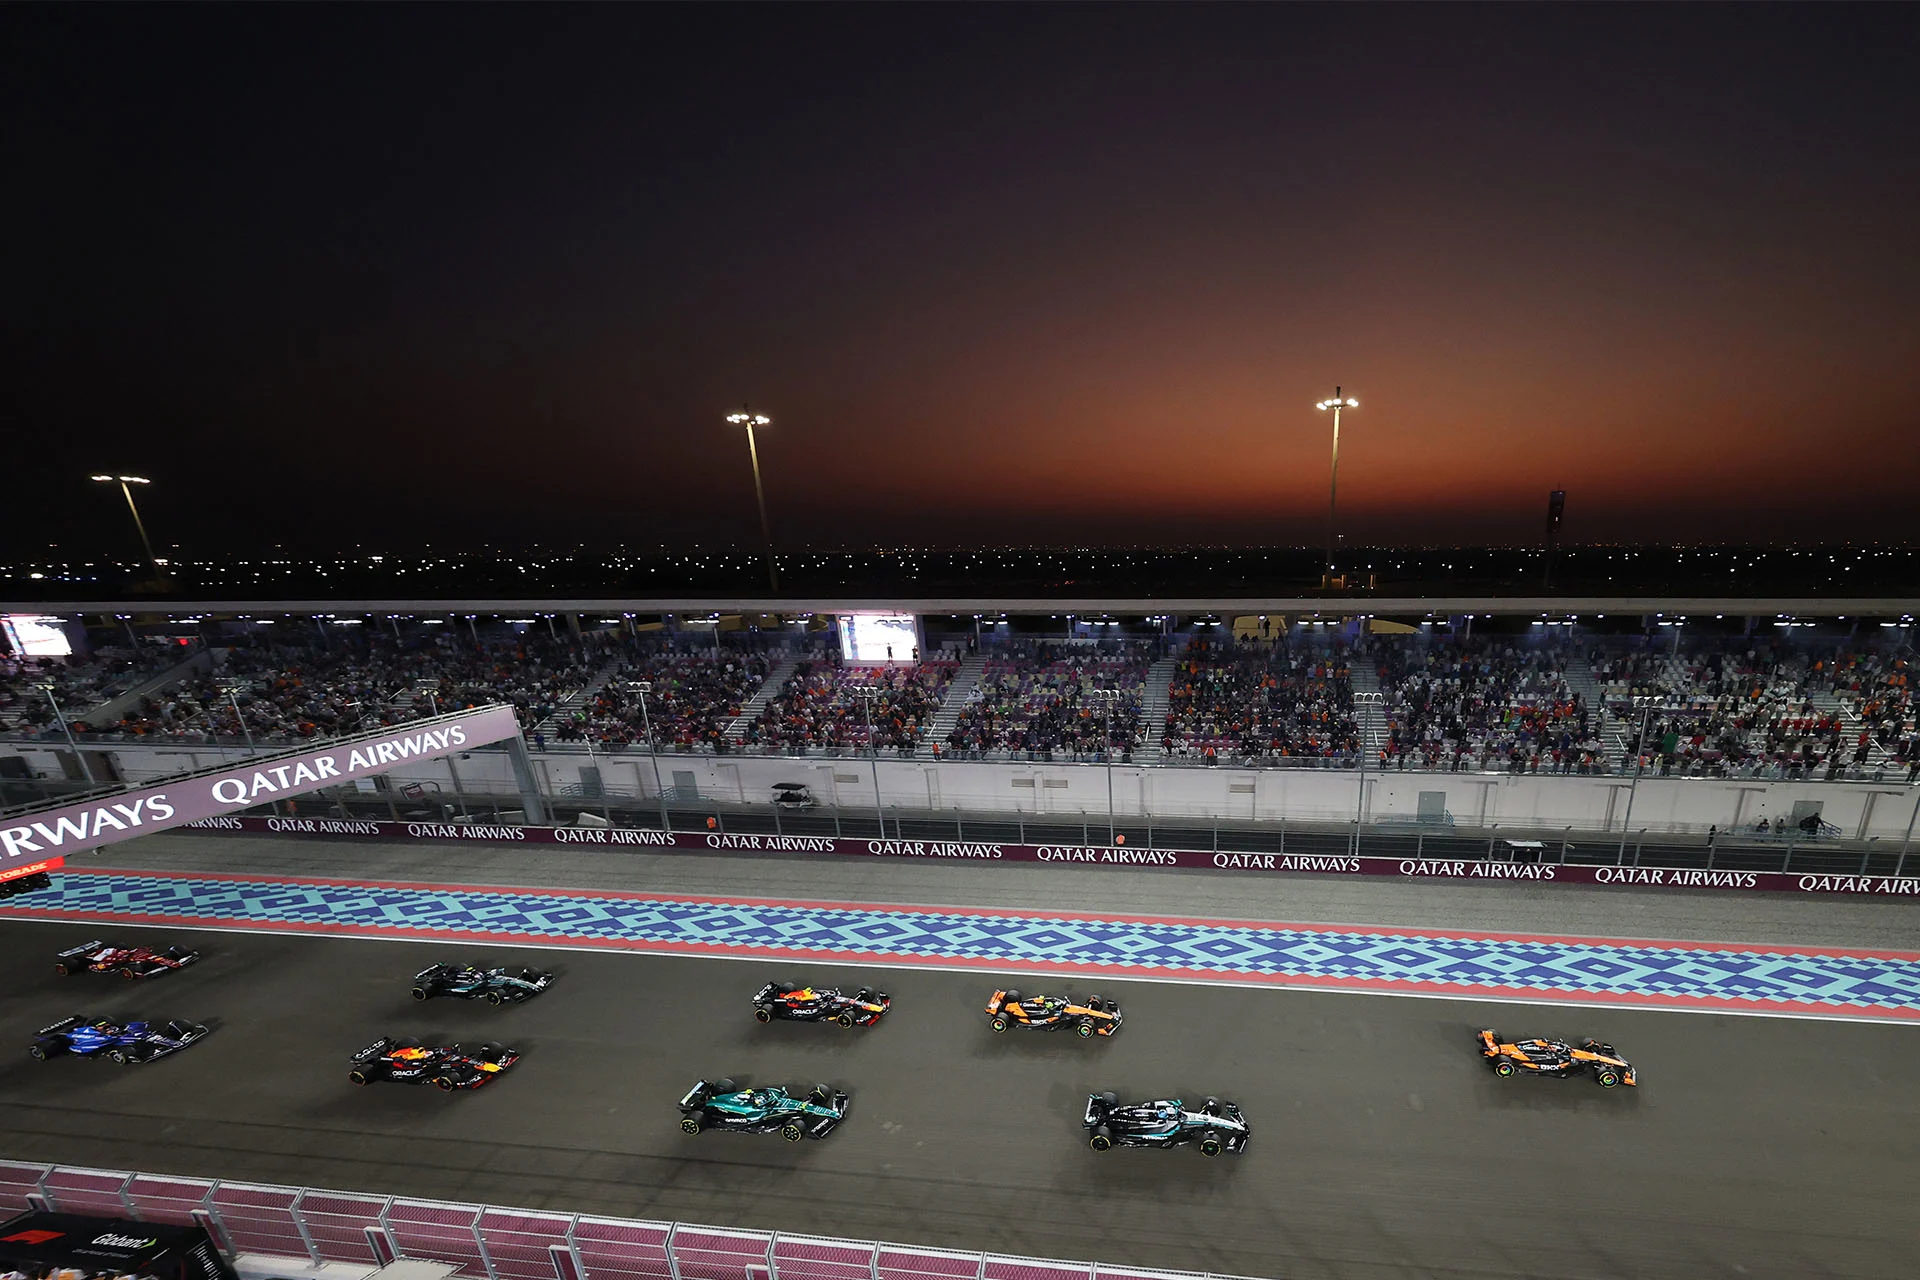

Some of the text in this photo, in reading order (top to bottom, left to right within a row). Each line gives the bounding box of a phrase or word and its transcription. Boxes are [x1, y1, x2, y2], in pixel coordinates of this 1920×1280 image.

[211, 722, 467, 805] QATAR AIRWAYS
[0, 793, 175, 860] RWAYS
[268, 819, 380, 835] QATAR AIRWAYS
[408, 824, 525, 840] QATAR AIRWAYS
[554, 829, 676, 846] QATAR AIRWAYS
[706, 834, 835, 852] QATAR AIRWAYS
[868, 841, 1002, 858] QATAR AIRWAYS
[1037, 846, 1177, 865] QATAR AIRWAYS
[1213, 853, 1360, 872] QATAR AIRWAYS
[1399, 860, 1555, 879] QATAR AIRWAYS
[1595, 867, 1757, 888] QATAR AIRWAYS
[1799, 875, 1872, 893] QATAR
[792, 1007, 819, 1017] ORACLE
[391, 1069, 421, 1078] ORACLE
[90, 1232, 149, 1251] Globant
